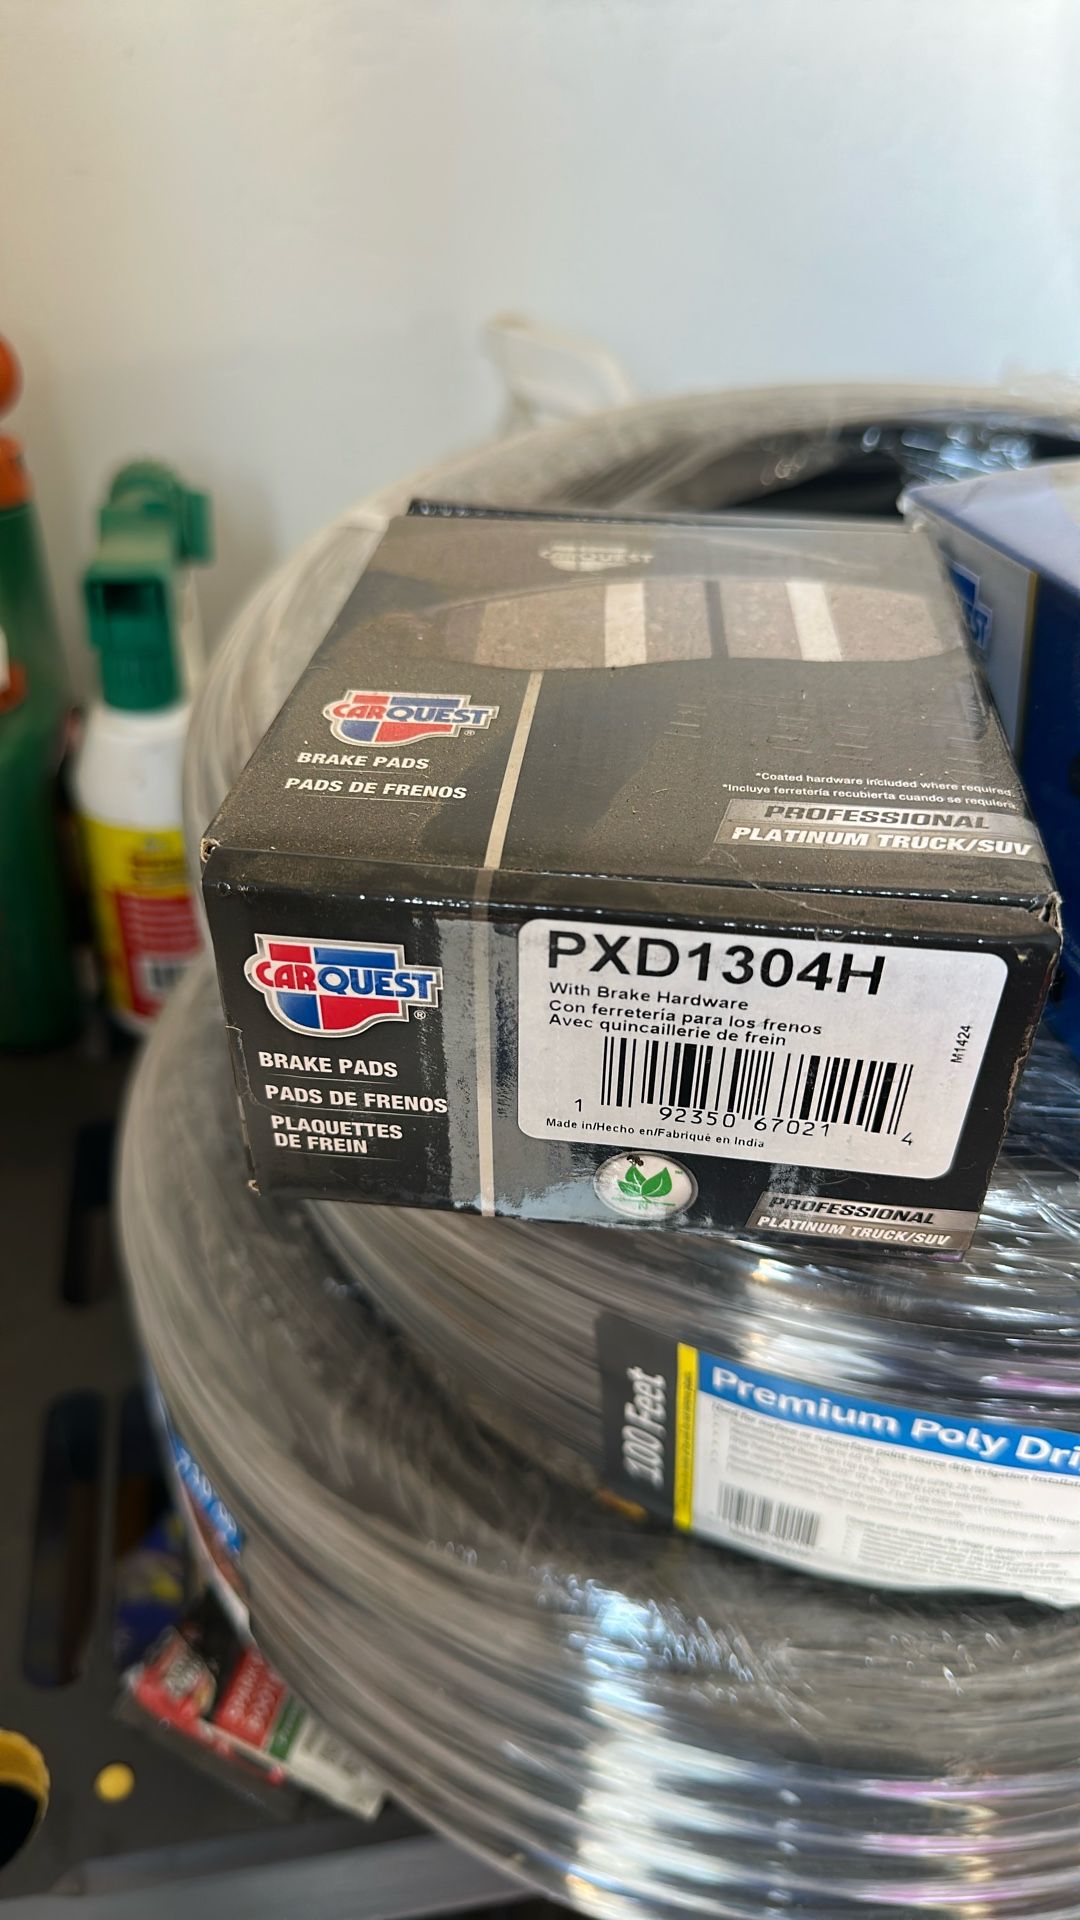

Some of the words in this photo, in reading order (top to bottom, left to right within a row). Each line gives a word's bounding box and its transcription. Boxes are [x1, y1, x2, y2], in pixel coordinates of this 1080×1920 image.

[333, 703, 490, 725] CARQUEST
[297, 752, 367, 768] BRAKE
[373, 756, 430, 770] PADS
[284, 778, 343, 793] PADS
[348, 781, 377, 795] DE
[383, 783, 467, 799] FRENOS
[806, 775, 863, 786] hardware
[866, 777, 917, 789] included
[920, 781, 958, 791] where
[833, 789, 896, 801] recubierta
[898, 793, 944, 803] cuando
[946, 795, 961, 804] se
[764, 805, 990, 830] PROFESSIONAL
[732, 827, 871, 847] PLATINUM
[877, 834, 1032, 856] TRUCK/SUV
[547, 930, 886, 995] PXD1304H
[255, 961, 433, 1000] CARQUEST
[549, 982, 591, 997] With
[597, 986, 651, 1002] Brake
[657, 991, 749, 1011] Hardware
[549, 1000, 586, 1014] Con
[592, 1003, 676, 1022] ferretería
[682, 1013, 723, 1027] para
[729, 1015, 756, 1030] los
[763, 1018, 822, 1035] frenos
[549, 1014, 593, 1029] Avec
[600, 1018, 711, 1039] quincaillerie
[716, 1029, 739, 1042] de
[745, 1031, 786, 1046] frein
[950, 1024, 972, 1064] M1424
[258, 1051, 333, 1074] BRAKE
[339, 1057, 398, 1078] PADS
[265, 1084, 323, 1105] PADS
[330, 1090, 358, 1108] DE
[364, 1093, 448, 1114] FRENOS
[270, 1115, 403, 1140] PLAQUETTES
[546, 1118, 577, 1129] Made
[581, 1120, 635, 1135] in/Hecho
[715, 1135, 730, 1144] en
[734, 1136, 765, 1148] India
[659, 1106, 736, 1128] 92350
[753, 1117, 830, 1137] 67021
[274, 1132, 302, 1149] DE
[308, 1137, 368, 1155] FREIN
[768, 1195, 935, 1225] PROFESSIONAL
[757, 1215, 846, 1236] PLATINUM
[850, 1225, 952, 1246] TRUCK/SUV
[624, 1366, 667, 1440] Feet
[712, 1366, 900, 1437] Premium
[911, 1417, 1010, 1458] Poly
[1015, 1434, 1080, 1470] Dri
[622, 1425, 664, 1491] 100
